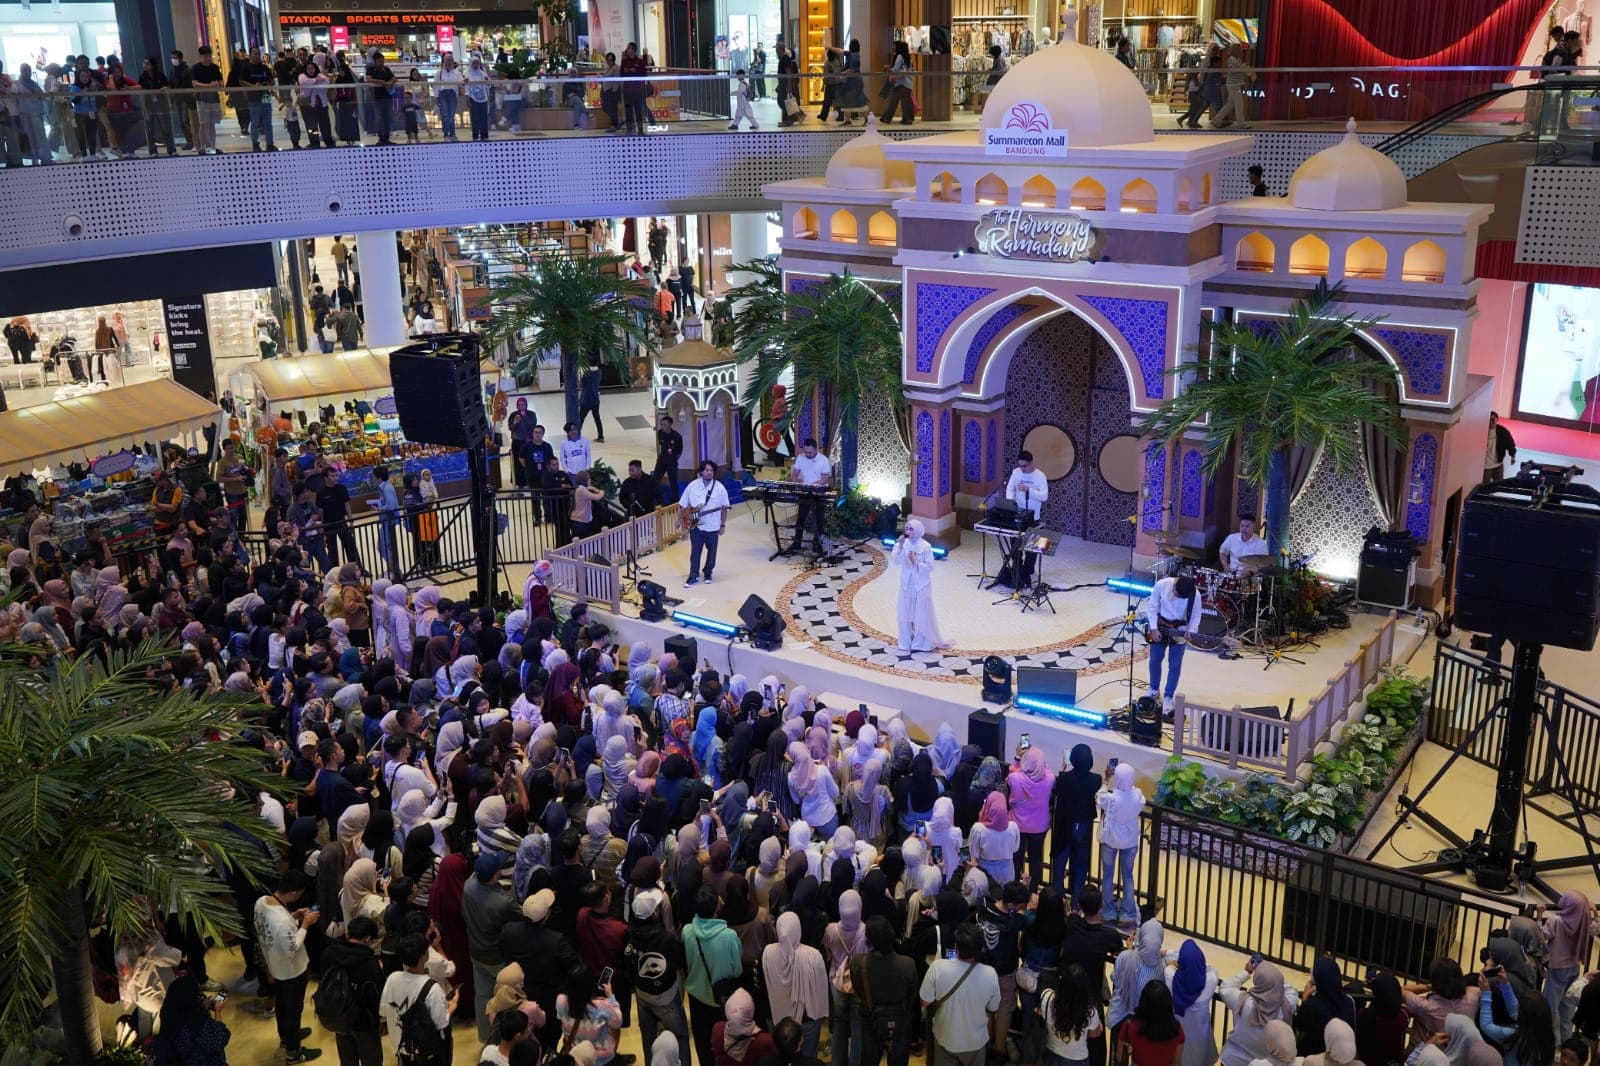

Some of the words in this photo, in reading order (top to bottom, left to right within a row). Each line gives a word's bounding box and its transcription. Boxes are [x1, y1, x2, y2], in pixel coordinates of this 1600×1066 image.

[279, 15, 331, 24] STATION
[346, 15, 399, 24] SPORTS
[402, 15, 454, 23] STATION
[988, 135, 1043, 146] Summarecon
[1046, 136, 1065, 146] Mall
[1005, 147, 1045, 155] BANDUNG
[994, 211, 1006, 225] The
[1007, 208, 1090, 252] Harmony
[987, 227, 1077, 259] Ramadan
[168, 304, 202, 312] Signature
